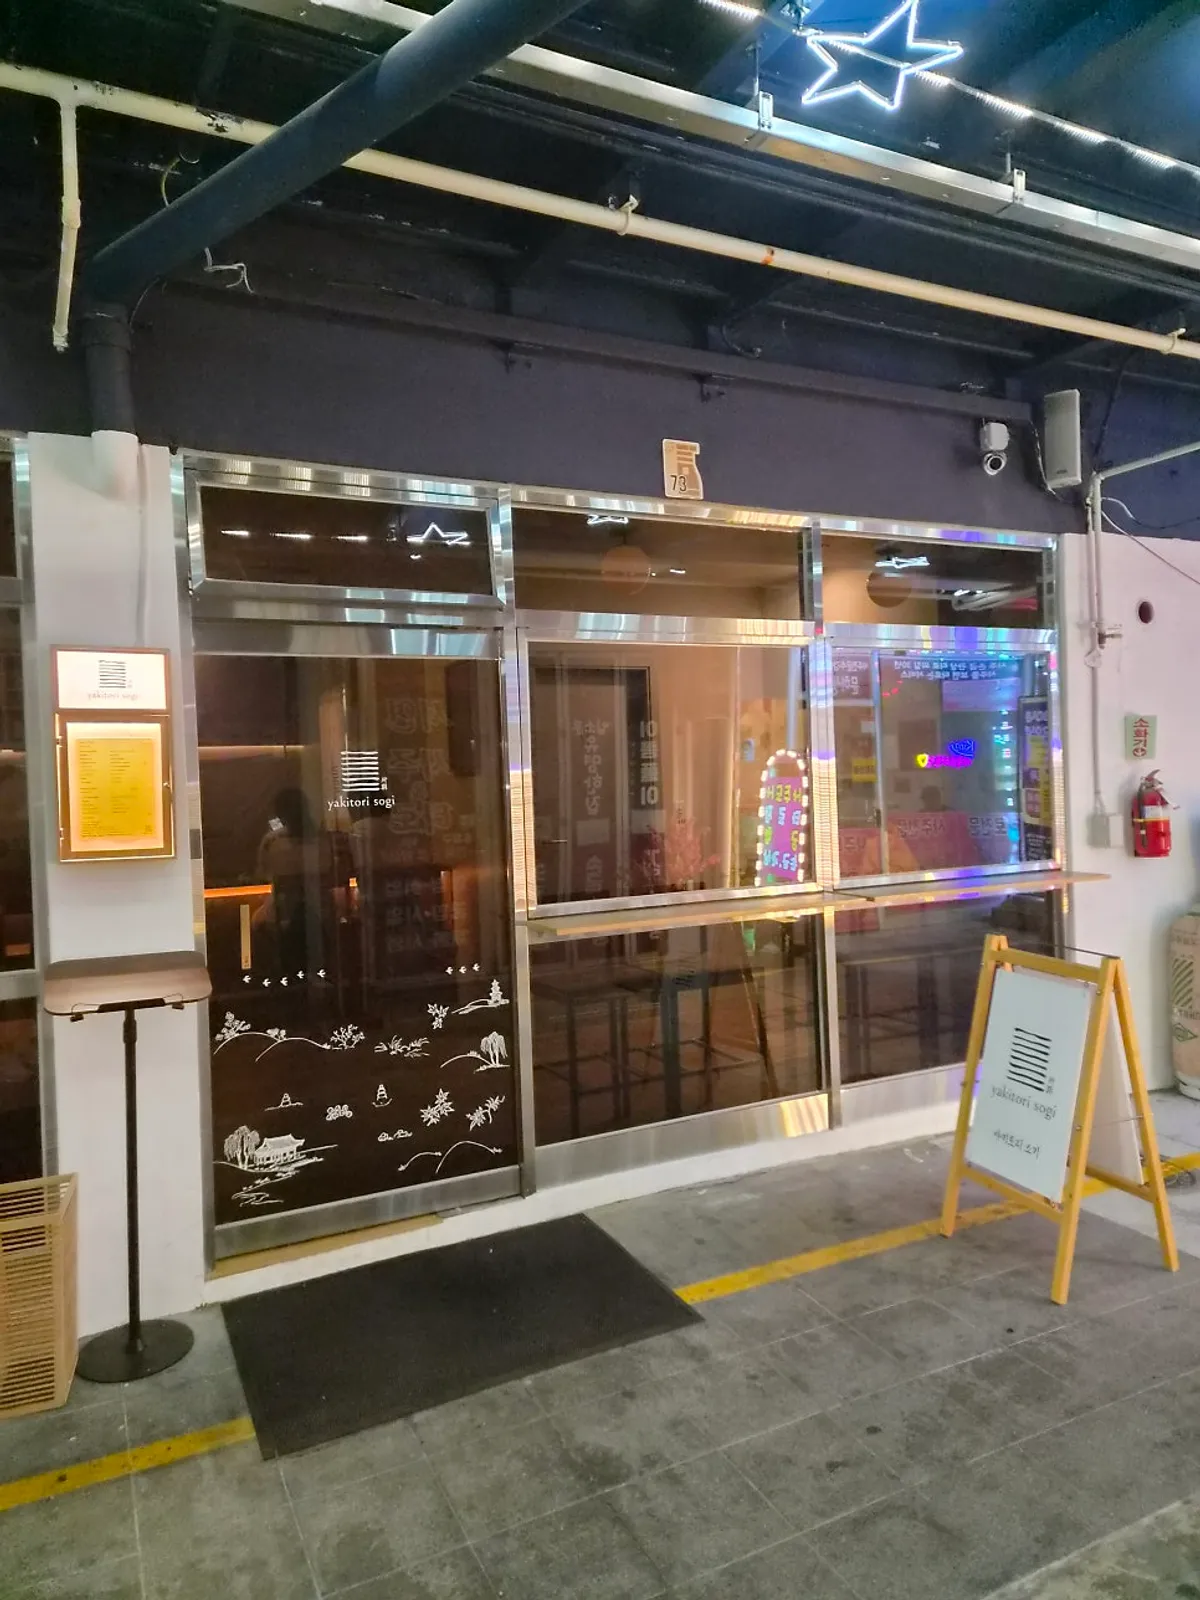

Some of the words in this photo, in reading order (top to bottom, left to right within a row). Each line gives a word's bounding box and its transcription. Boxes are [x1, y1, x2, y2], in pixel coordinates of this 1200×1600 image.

[670, 474, 687, 492] 73
[1133, 717, 1150, 748] 소화기
[327, 796, 370, 811] yakitori
[373, 795, 395, 809] sogi
[990, 1084, 1031, 1109] yakitori
[1033, 1102, 1058, 1121] sogi
